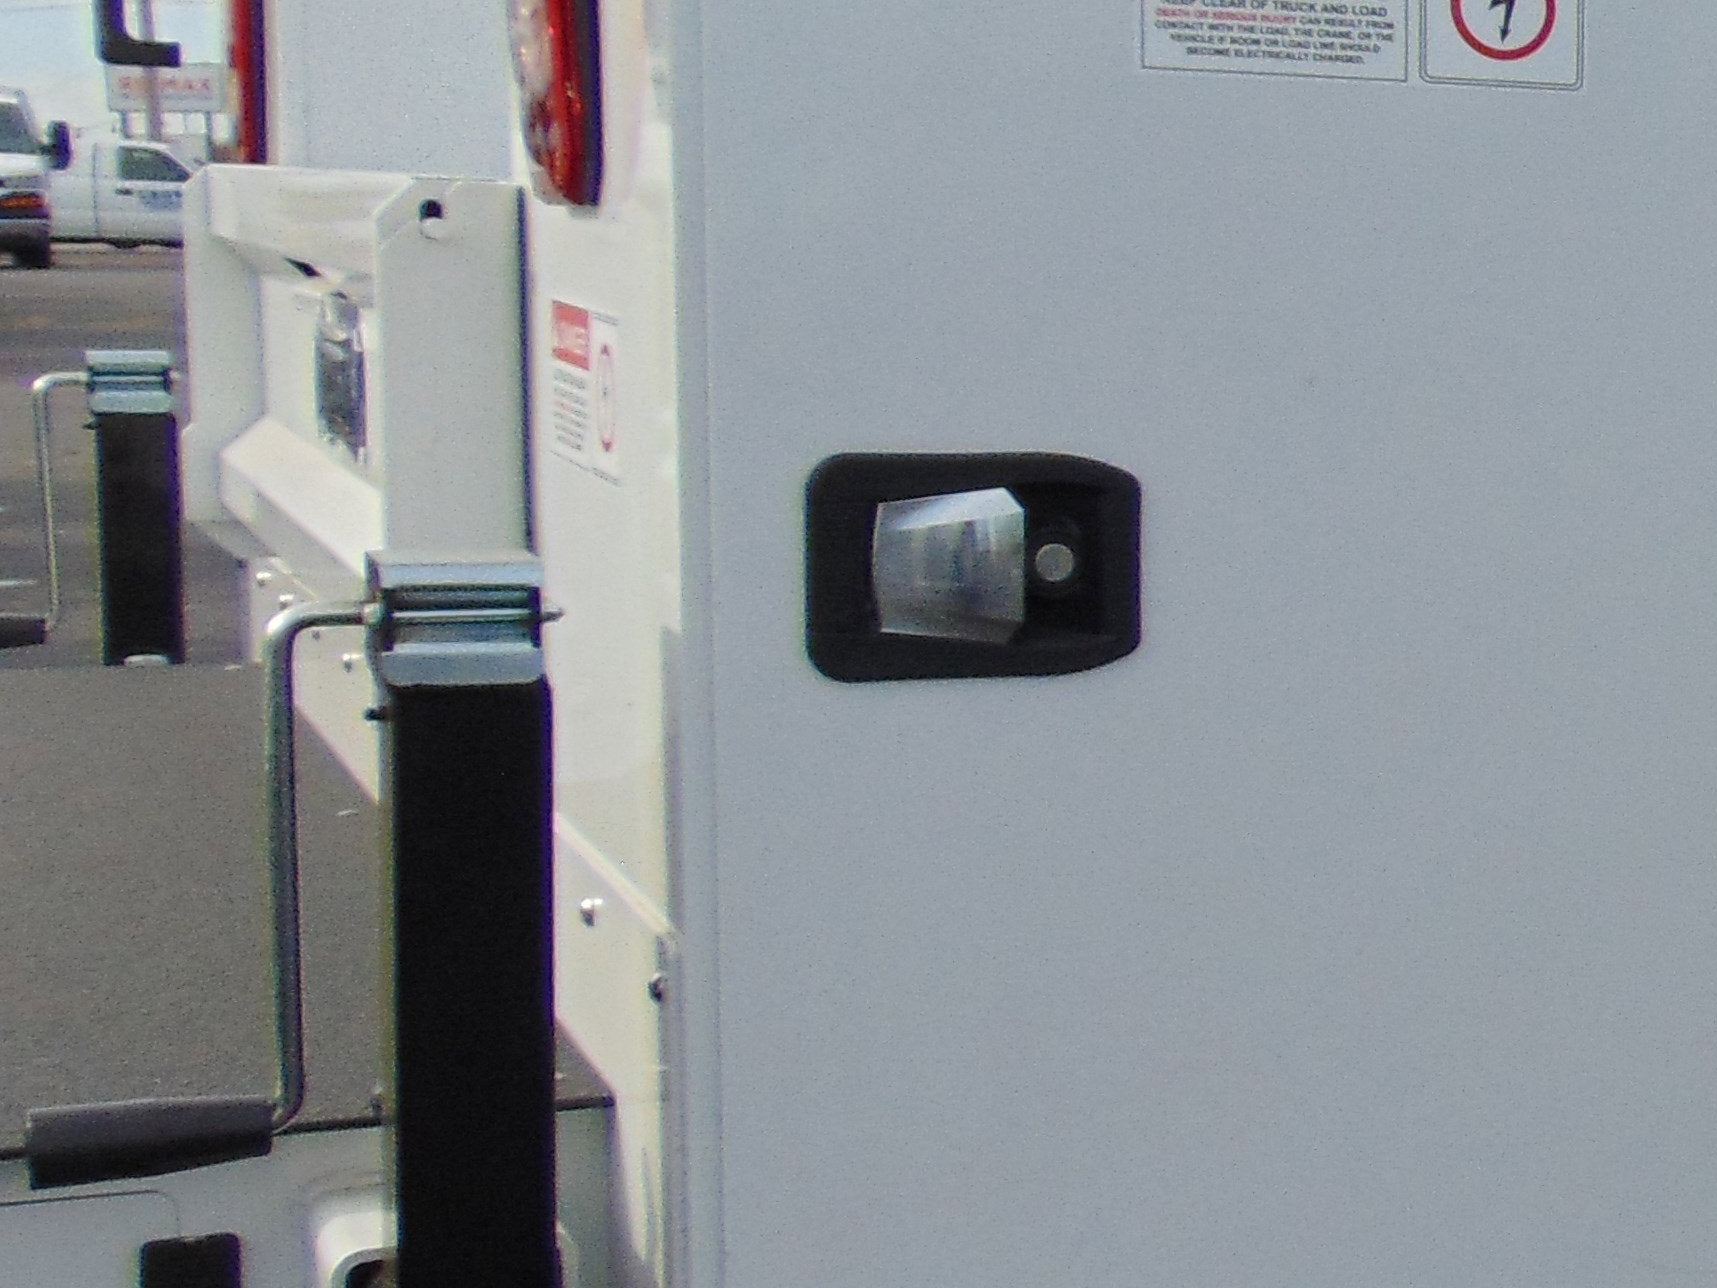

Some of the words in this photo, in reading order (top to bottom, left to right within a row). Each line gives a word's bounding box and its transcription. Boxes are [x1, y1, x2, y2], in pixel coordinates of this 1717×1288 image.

[1272, 0, 1318, 12] TRUCK
[1320, 3, 1349, 15] AND
[1351, 4, 1388, 18] LOAD
